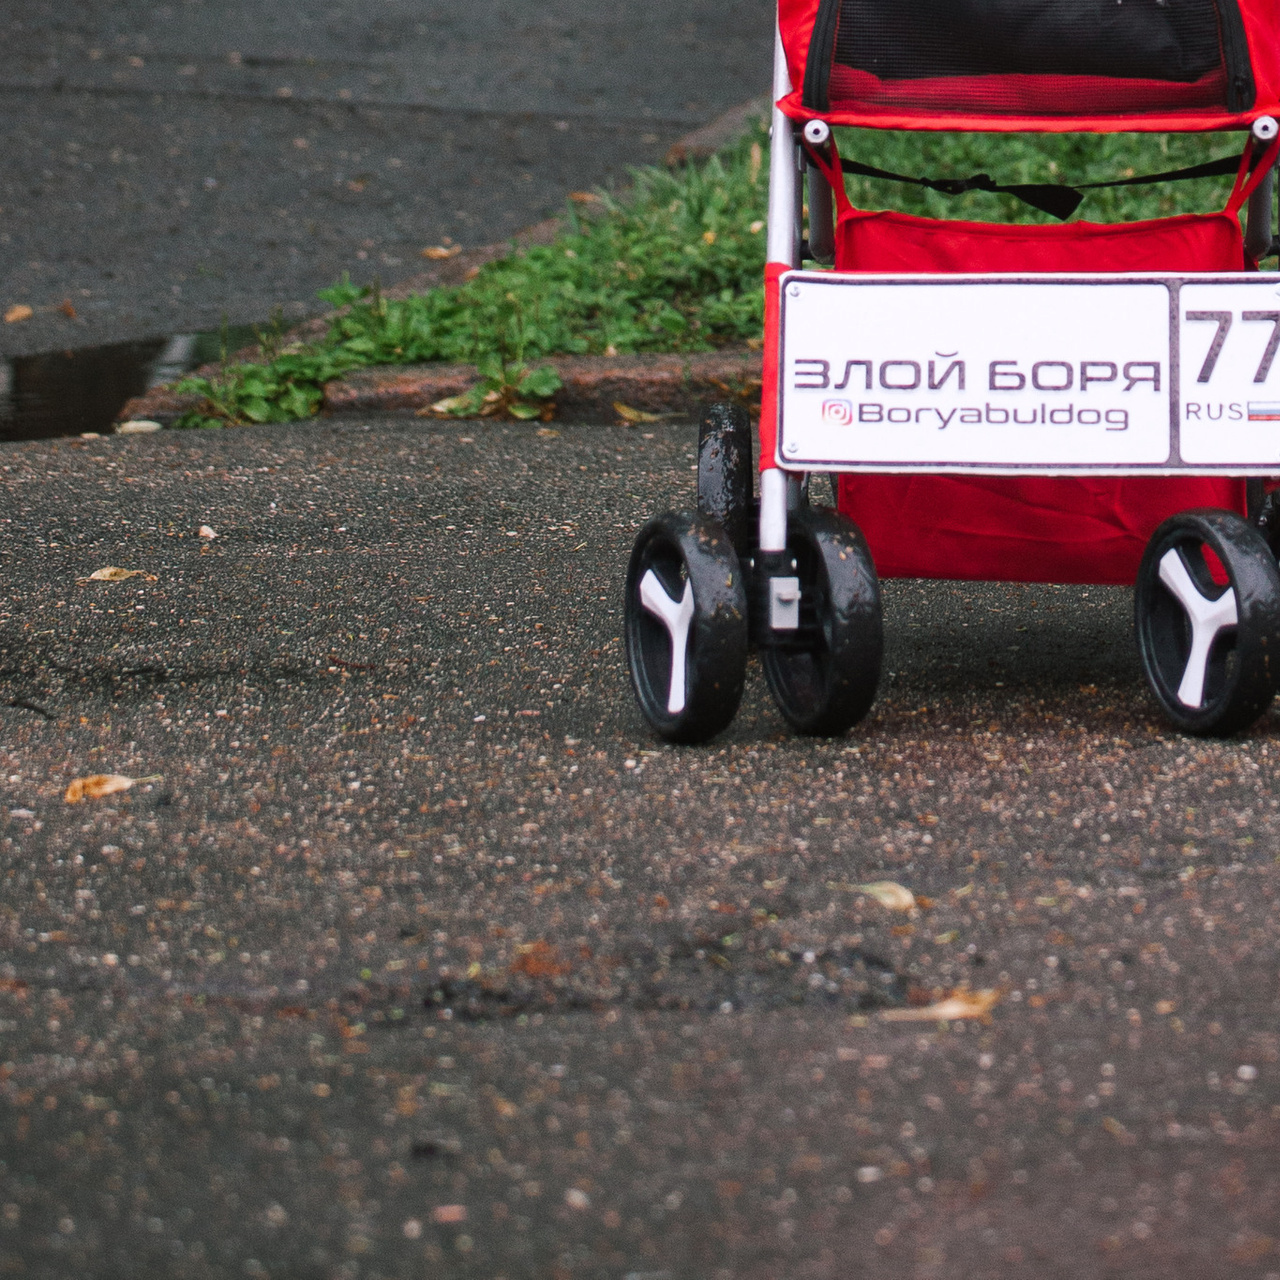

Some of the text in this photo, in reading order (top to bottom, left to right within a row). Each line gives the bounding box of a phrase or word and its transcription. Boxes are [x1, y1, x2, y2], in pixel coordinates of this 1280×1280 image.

[794, 351, 1161, 392] ЗЛОЙ БОРЯ
[858, 402, 1129, 432] Boryabuldog
[1186, 402, 1243, 421] RUS
